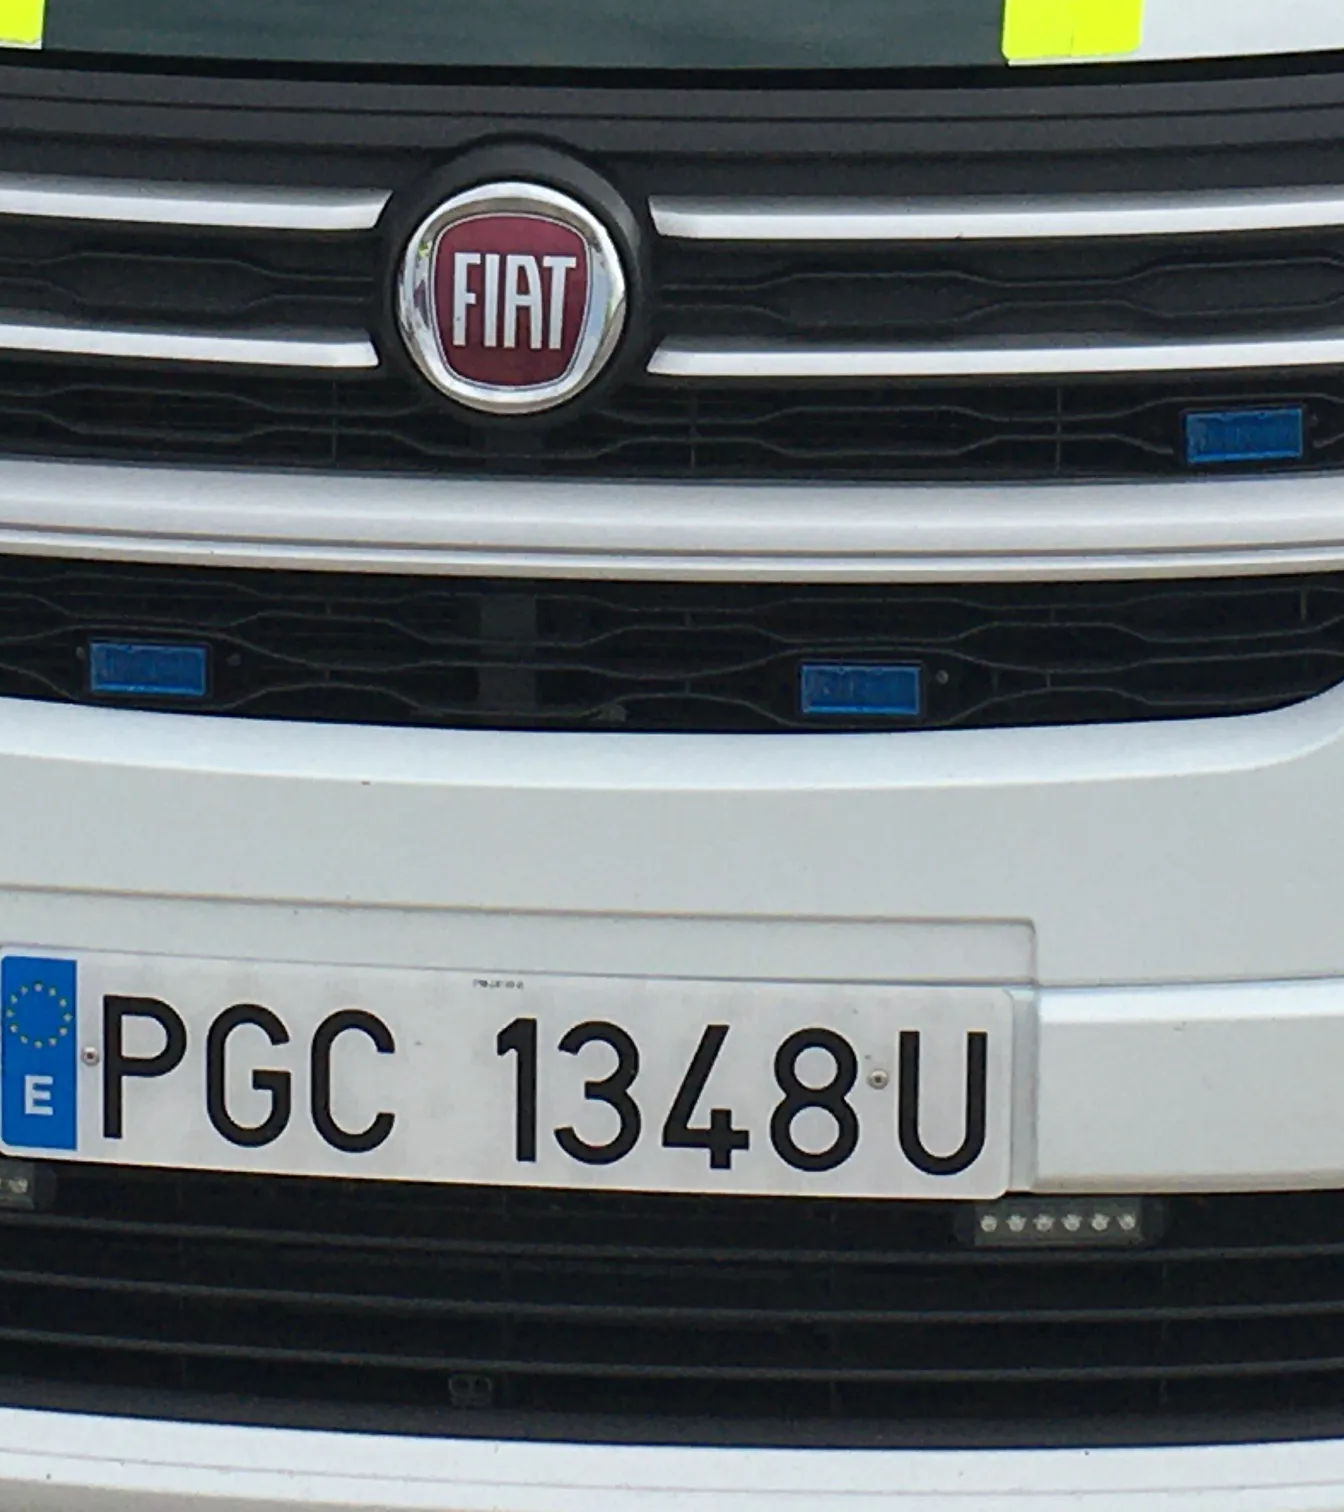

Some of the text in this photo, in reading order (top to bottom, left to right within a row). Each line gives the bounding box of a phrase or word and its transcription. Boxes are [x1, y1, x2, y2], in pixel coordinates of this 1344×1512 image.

[452, 251, 577, 350] FIAT
[24, 1075, 53, 1115] E
[101, 993, 396, 1155] PGC
